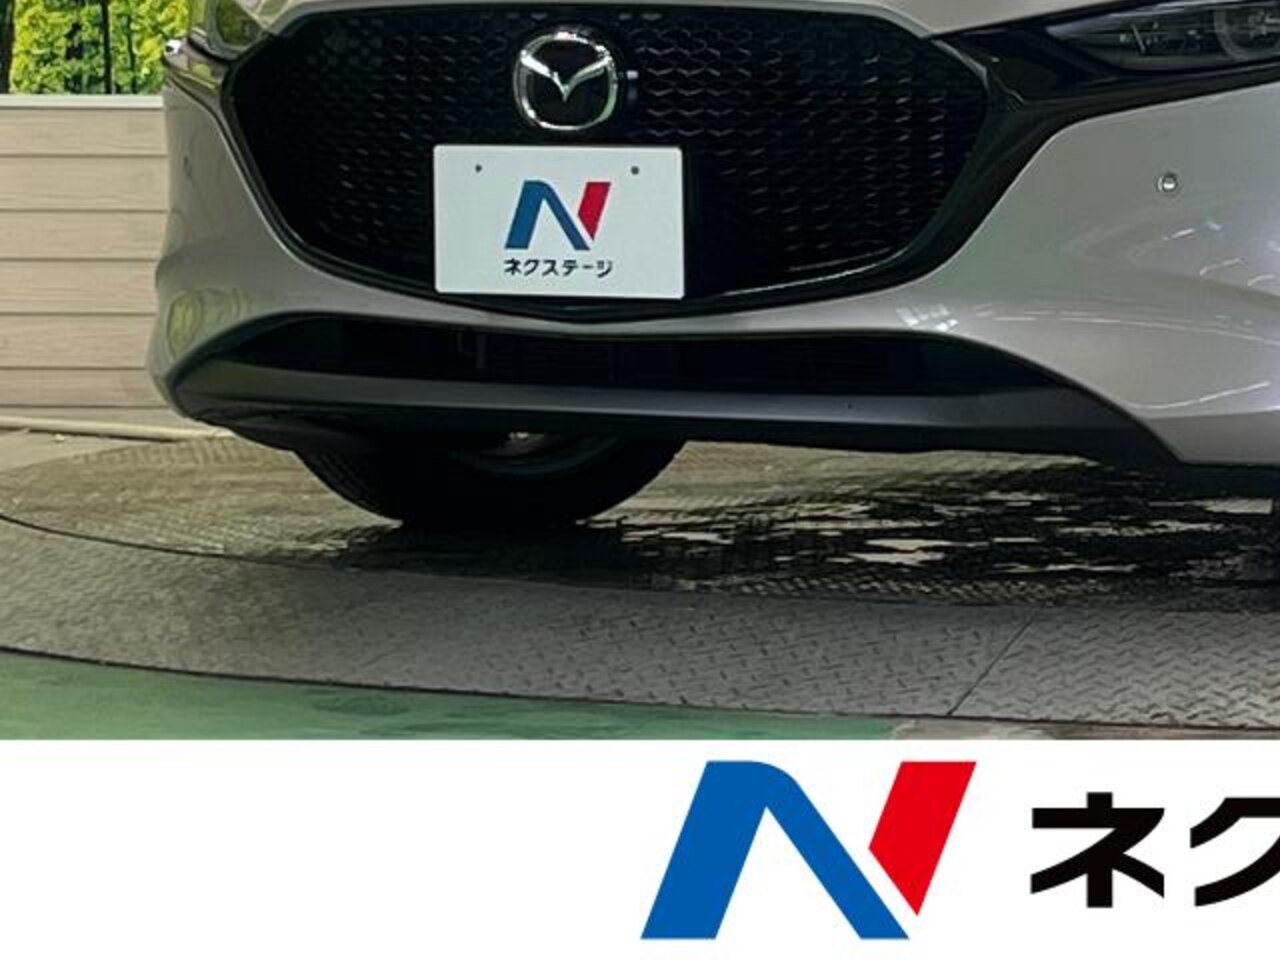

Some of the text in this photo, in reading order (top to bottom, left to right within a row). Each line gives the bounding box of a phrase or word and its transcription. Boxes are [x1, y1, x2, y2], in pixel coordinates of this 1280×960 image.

[504, 258, 613, 278] ネクステージ
